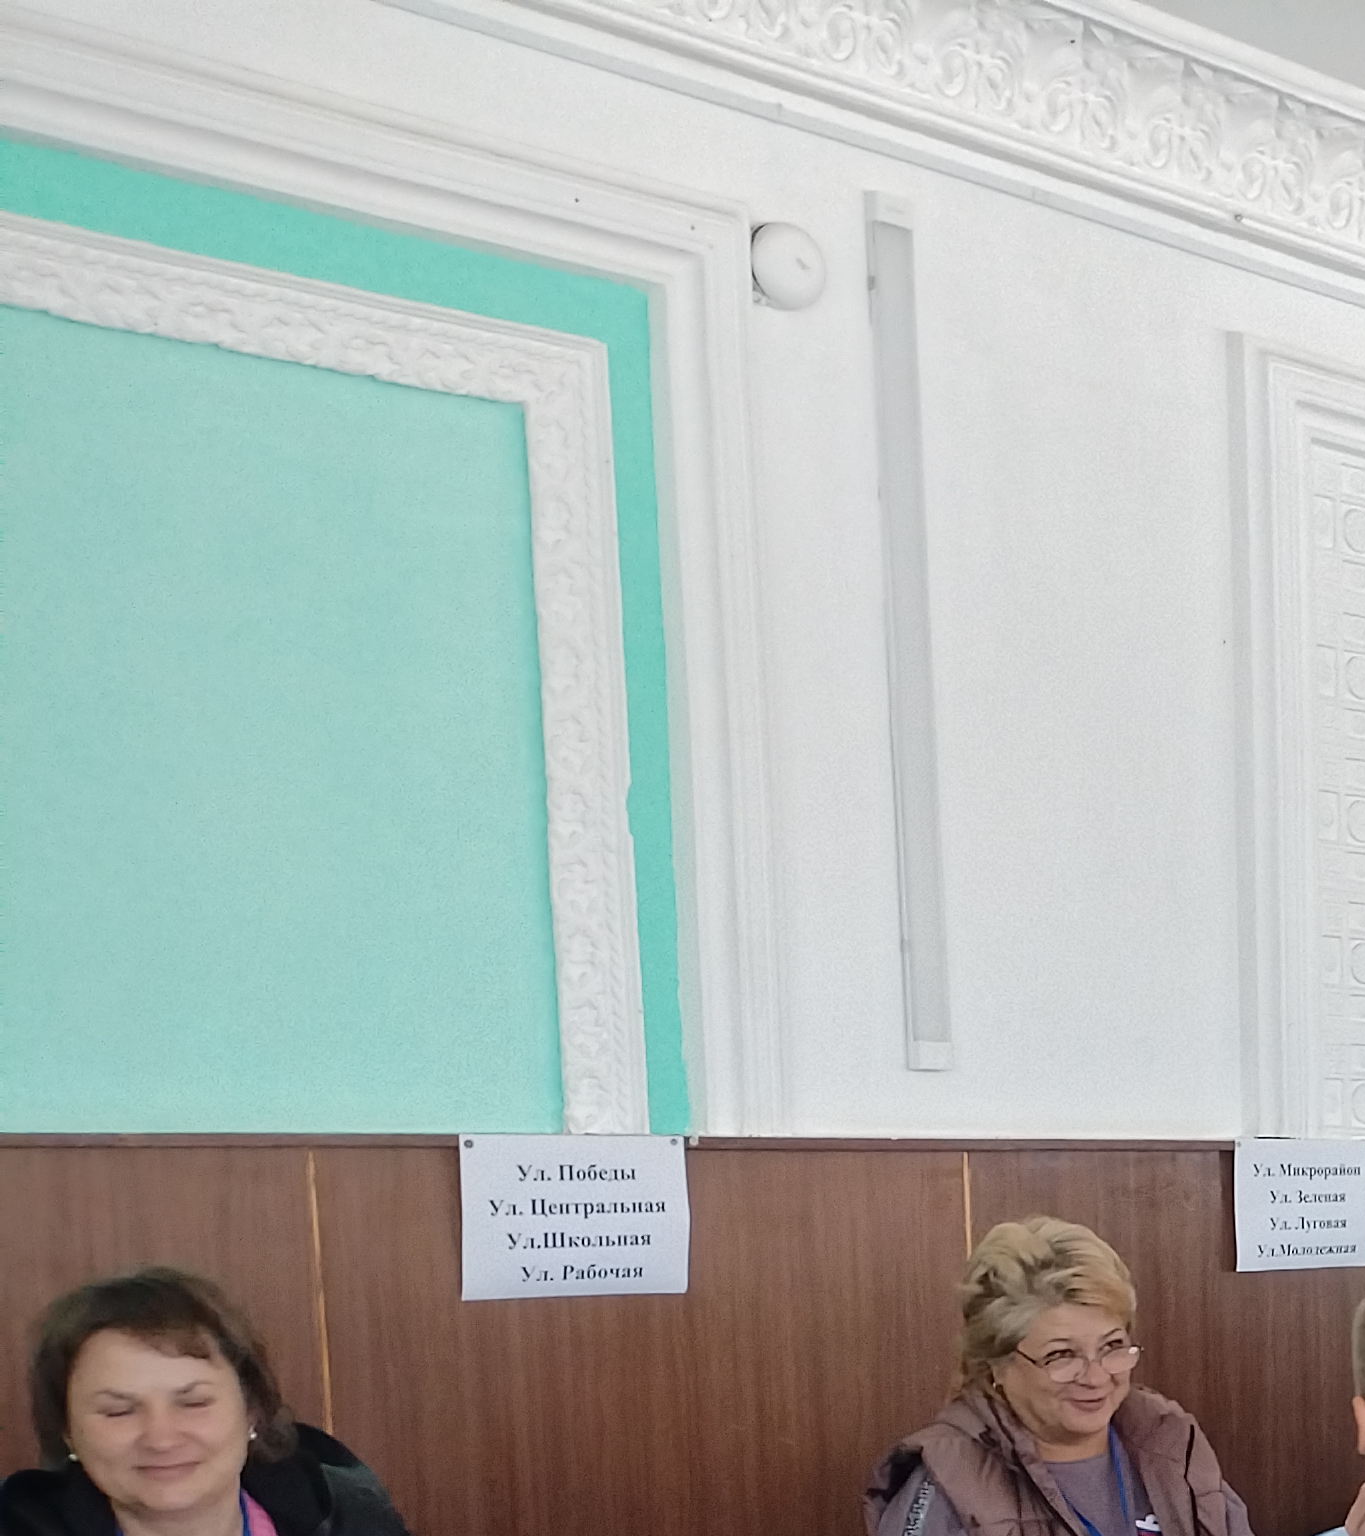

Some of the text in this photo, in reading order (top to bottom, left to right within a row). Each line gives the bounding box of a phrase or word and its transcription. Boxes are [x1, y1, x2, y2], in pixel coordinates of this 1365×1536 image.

[517, 1163, 636, 1183] Ул. Победы
[1253, 1162, 1361, 1180] Ул. Микрорайон
[1269, 1189, 1347, 1204] Ул. Зеленая
[489, 1197, 667, 1219] Ул. Центральная
[1269, 1216, 1347, 1234] Ул. Луговая
[520, 1262, 645, 1283] Ул. Рабочая
